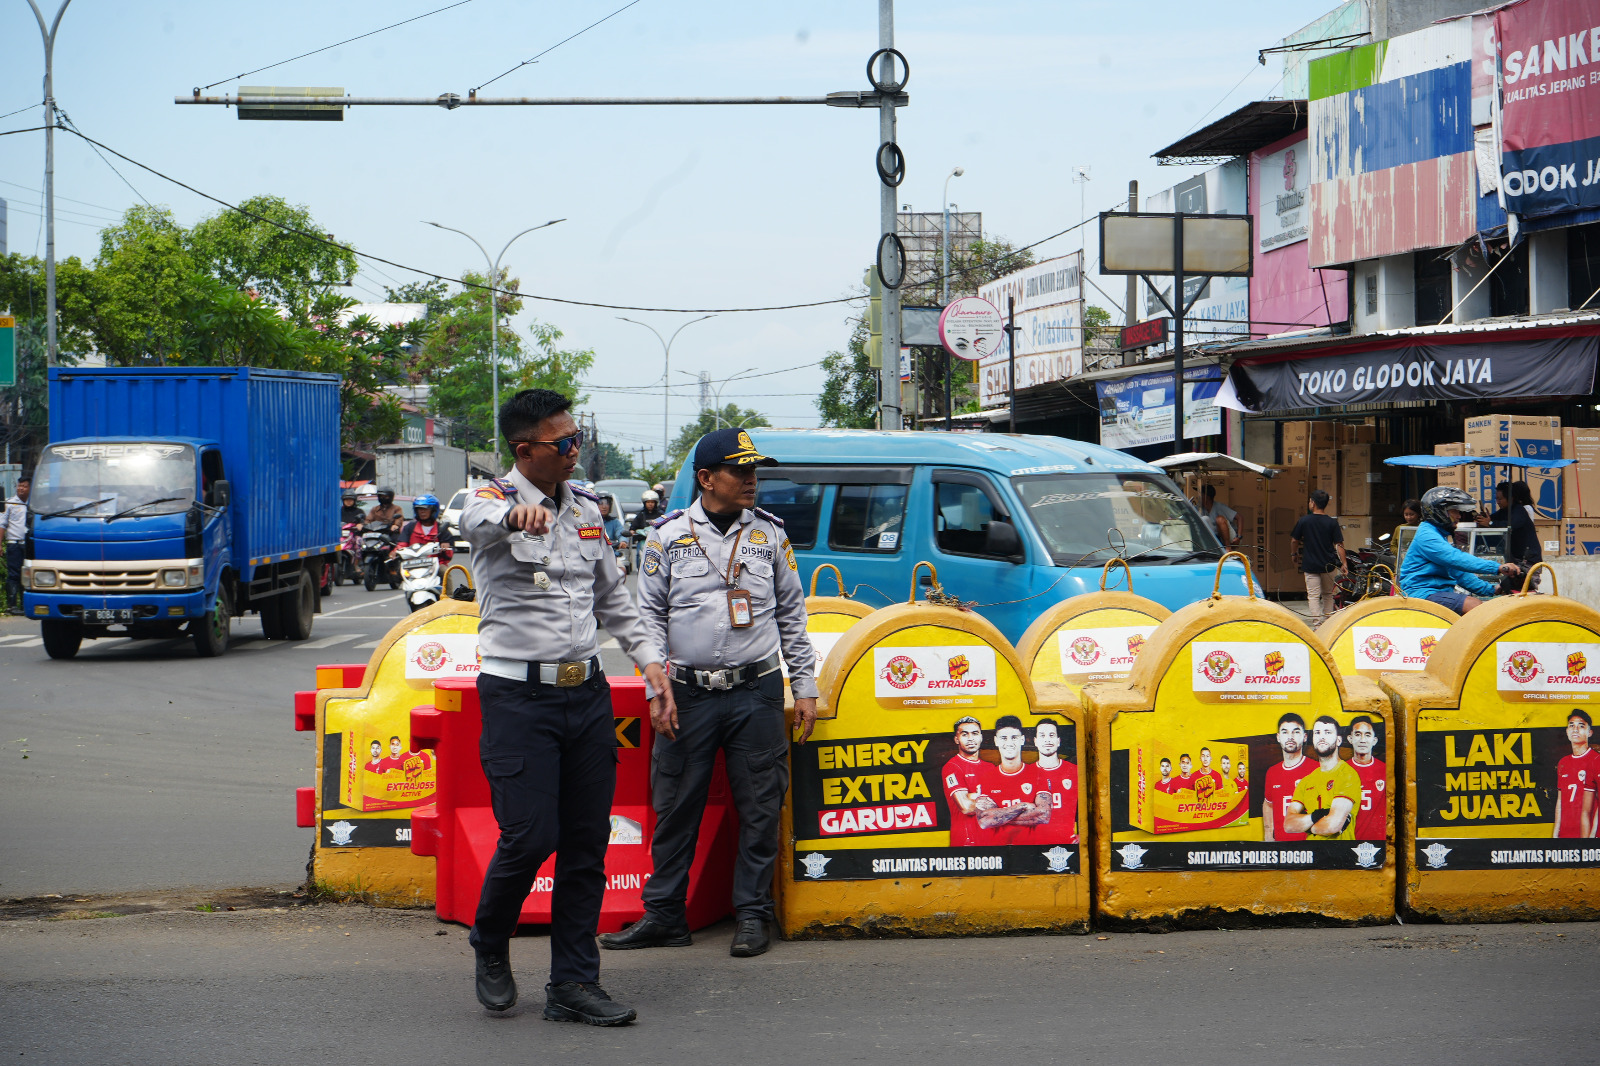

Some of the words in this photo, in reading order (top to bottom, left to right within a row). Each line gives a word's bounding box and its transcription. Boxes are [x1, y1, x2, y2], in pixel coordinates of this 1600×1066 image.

[1548, 75, 1586, 95] JEPANG
[1503, 162, 1577, 197] ODOK
[1225, 299, 1246, 320] JAYA
[1032, 309, 1074, 347] Panasonic
[986, 363, 1022, 401] SHAP
[1299, 368, 1347, 396] TOKO
[1352, 361, 1435, 391] GLODOK
[1441, 358, 1492, 386] JAYA
[1468, 420, 1492, 429] SANKEN
[580, 529, 600, 537] DISHUB
[881, 534, 895, 542] 08
[670, 550, 680, 559] TRI
[741, 546, 773, 560] DISHUB
[928, 679, 986, 689] EXTRAJOSS
[1244, 675, 1301, 684] EXTRAJOSS
[818, 740, 930, 770] ENERGY
[1444, 732, 1533, 767] LAKI
[386, 781, 435, 792] EXTRAJOSS
[823, 772, 931, 805] EXTRA
[1445, 770, 1536, 791] MENTAL
[400, 790, 422, 798] ACTIVE
[1568, 783, 1577, 802] 7
[1178, 802, 1228, 813] EXTRAJOSS
[1440, 793, 1542, 820] JUARA
[820, 805, 933, 833] GARUDA
[872, 857, 928, 873] SATLANTAS
[929, 857, 966, 872] POLRES
[967, 856, 1003, 871] BOGOR
[1187, 852, 1241, 865] SATLANTAS
[1242, 851, 1279, 864] POLRES
[1280, 850, 1314, 864] BOGOR
[1491, 850, 1544, 864] SATLANTAS
[1545, 849, 1581, 863] POLRES
